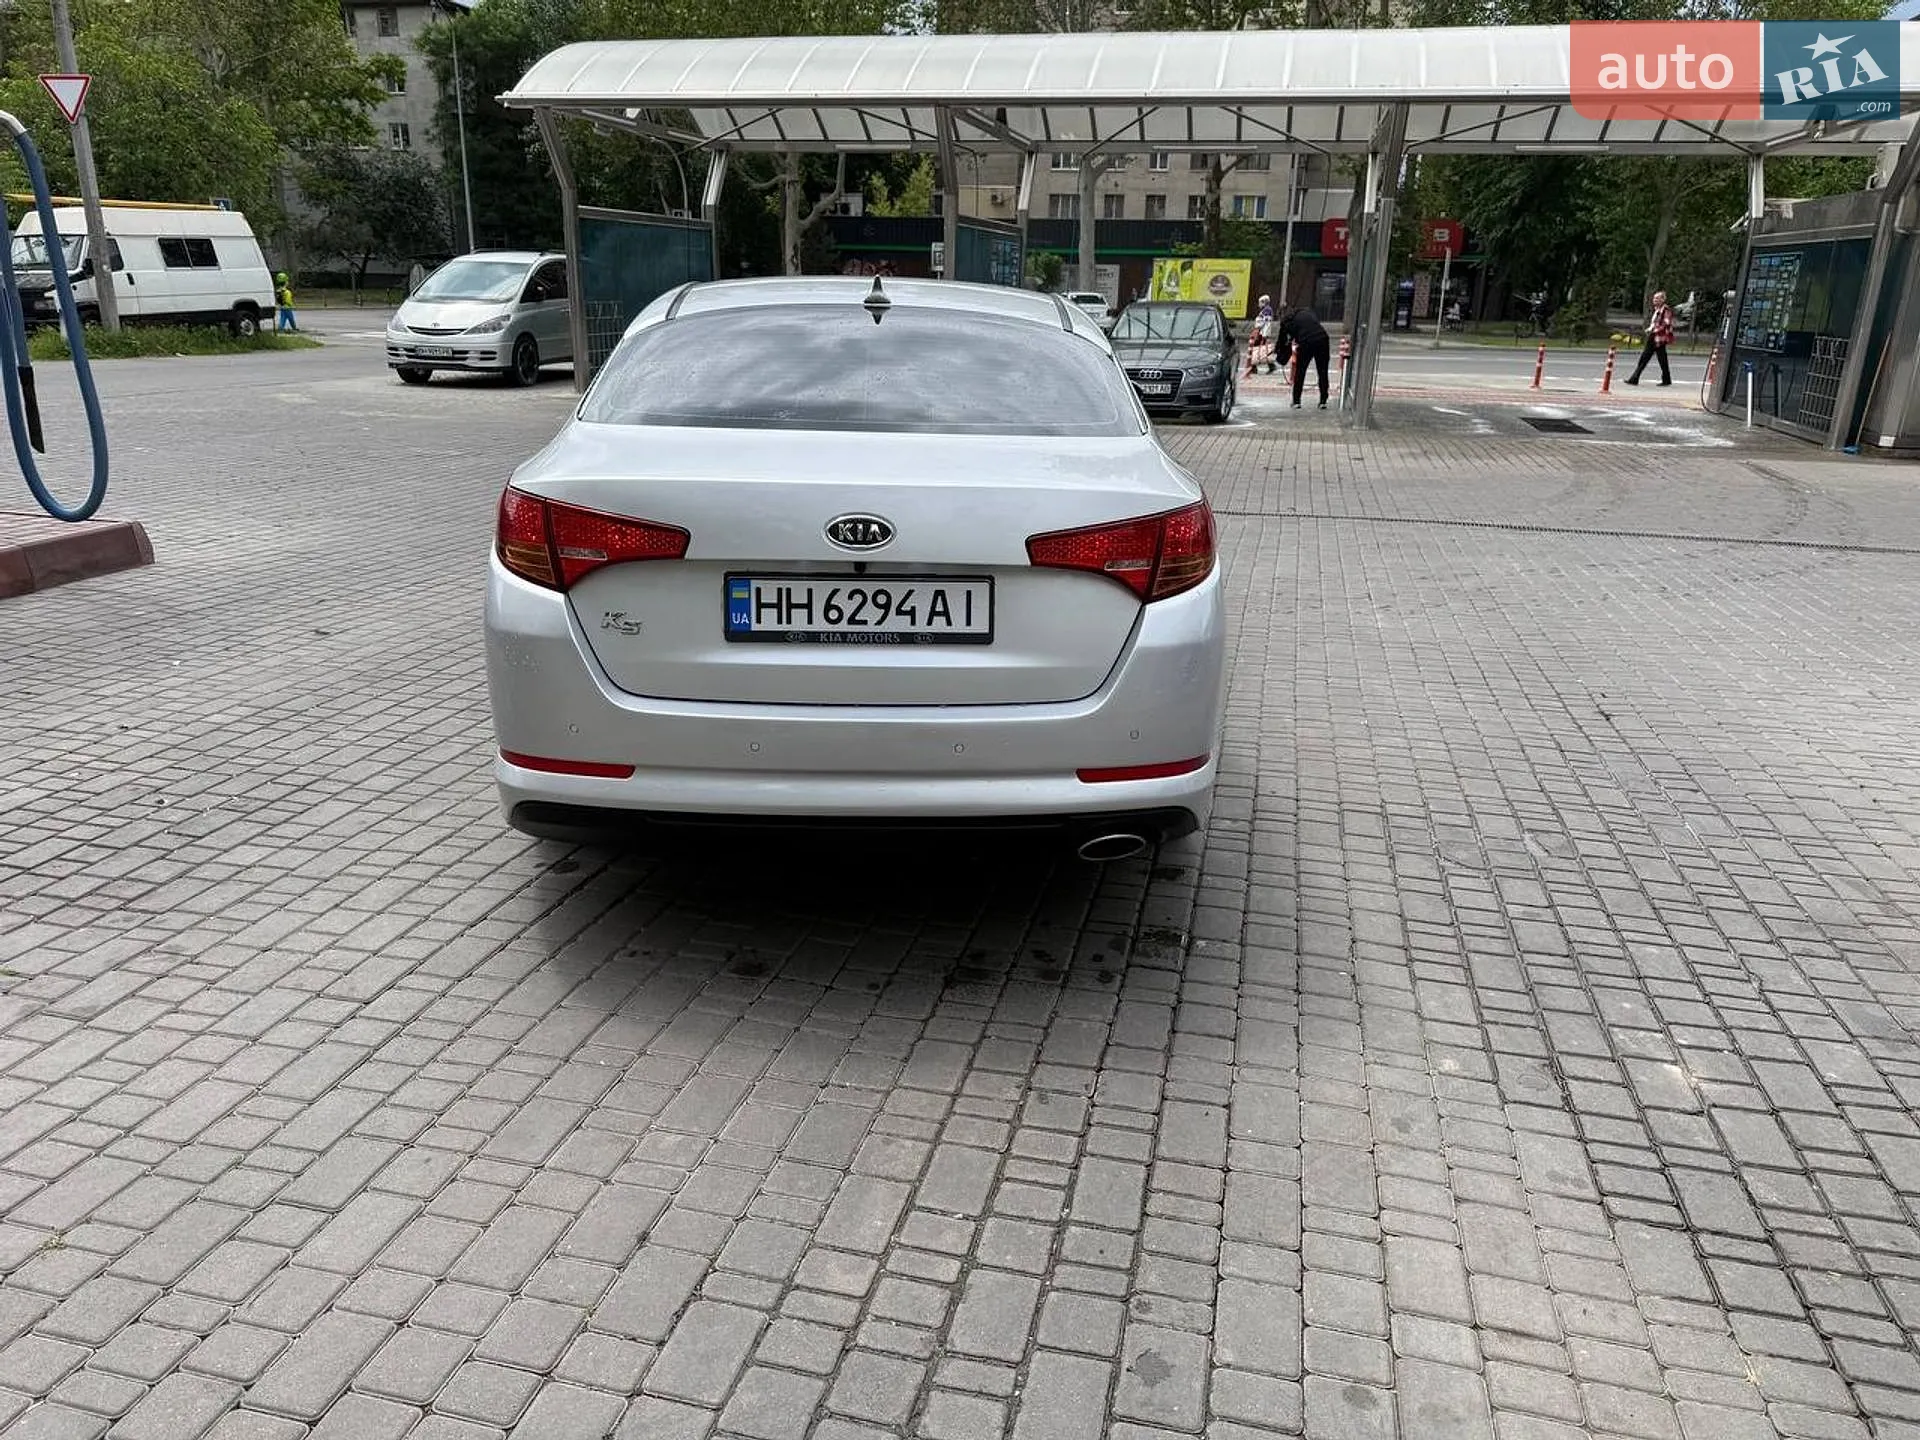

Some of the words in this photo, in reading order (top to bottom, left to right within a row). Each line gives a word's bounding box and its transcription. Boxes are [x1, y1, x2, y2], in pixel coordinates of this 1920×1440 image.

[838, 523, 883, 541] KIA
[732, 613, 750, 625] UA
[819, 632, 841, 643] KIA
[846, 632, 900, 644] MOTORS
